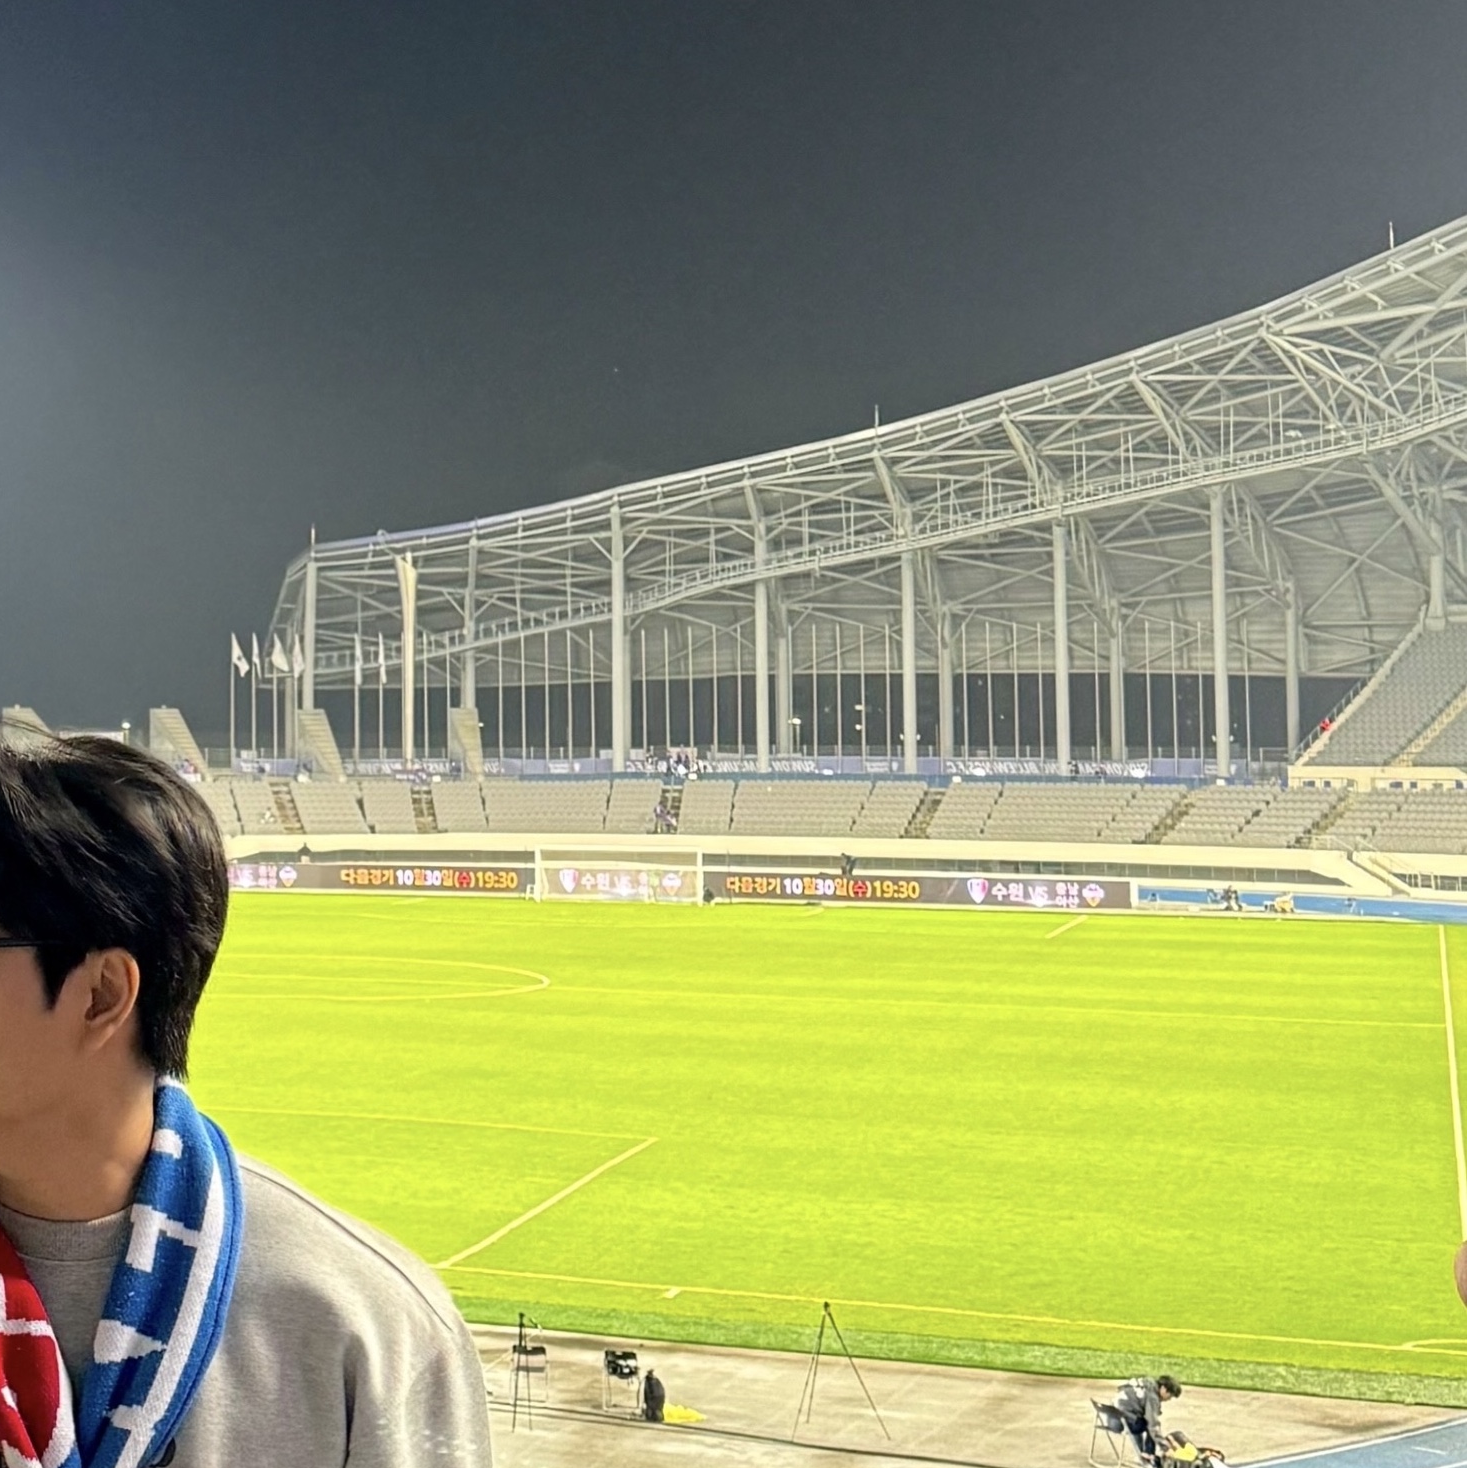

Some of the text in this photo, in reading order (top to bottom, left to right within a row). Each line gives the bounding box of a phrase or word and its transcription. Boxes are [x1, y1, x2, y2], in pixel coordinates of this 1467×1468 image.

[340, 870, 394, 886] 다음경기
[477, 871, 518, 889] 19:30
[726, 877, 781, 895] 다음경기
[873, 880, 920, 898] 19:30
[991, 882, 1025, 901] 수원
